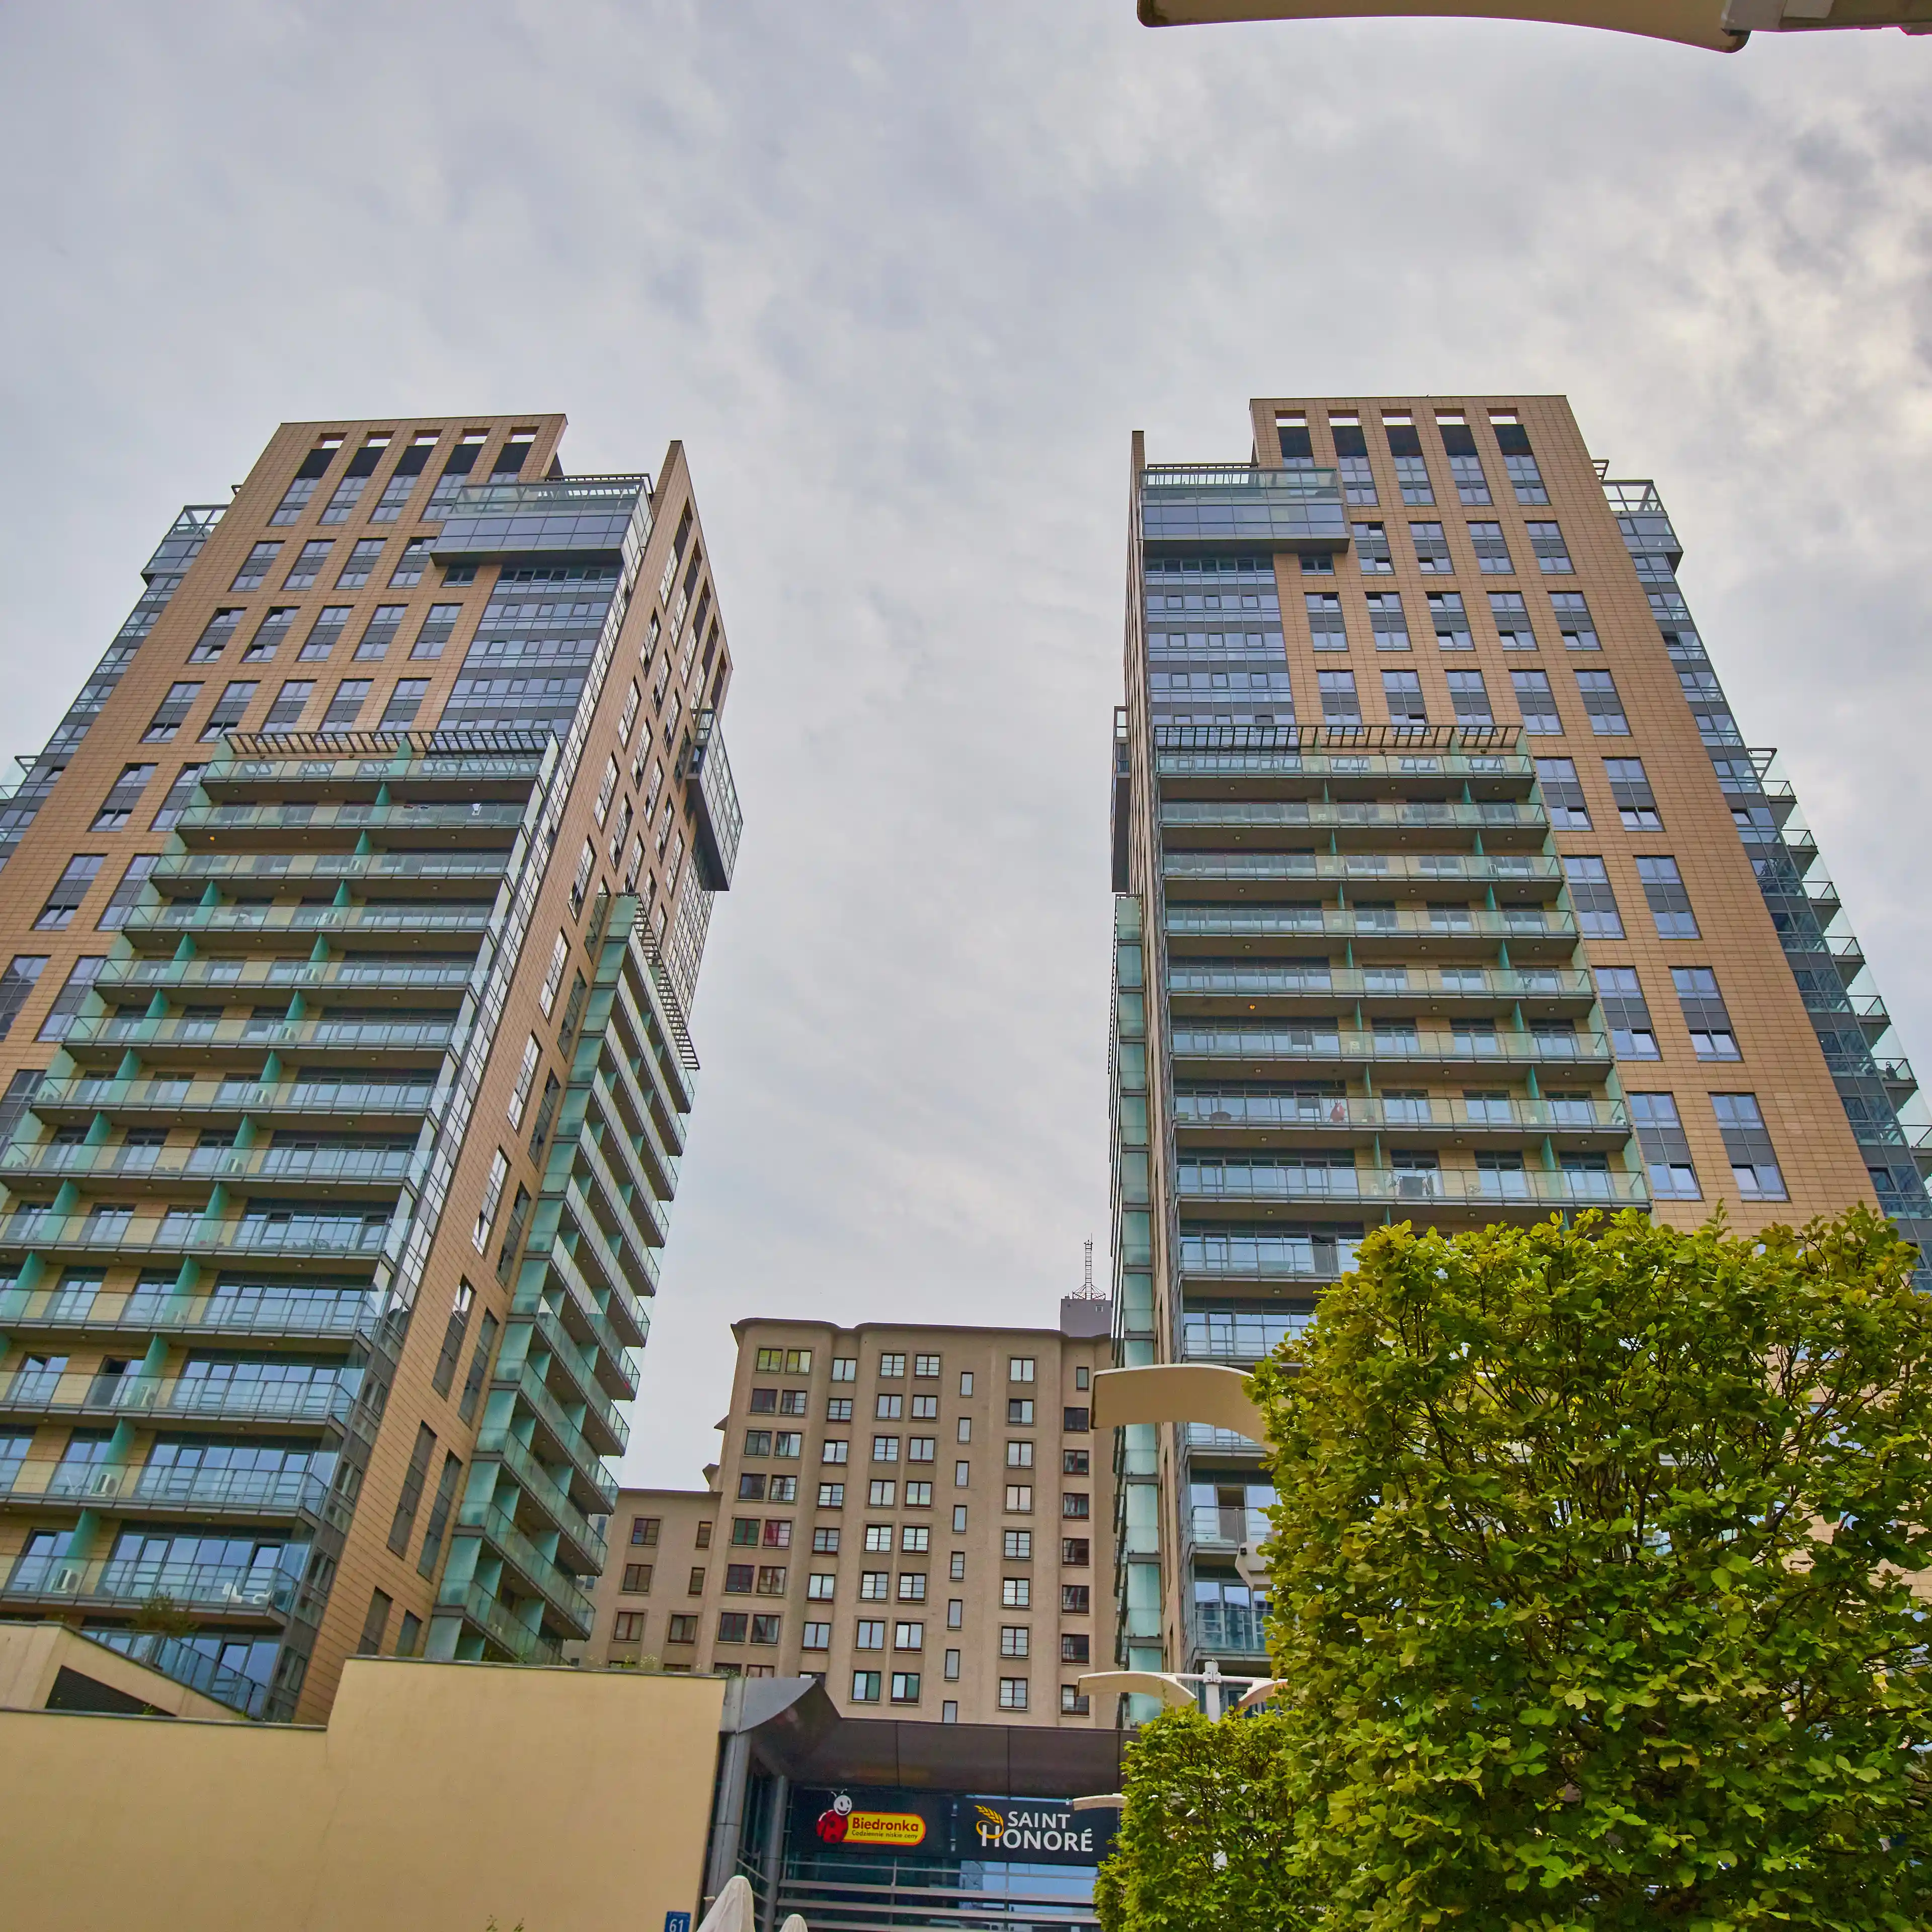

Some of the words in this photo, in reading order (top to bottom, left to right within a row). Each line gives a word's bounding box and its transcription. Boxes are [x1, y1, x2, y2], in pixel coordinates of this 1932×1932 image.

[852, 1817, 919, 1831] Biedronka
[1007, 1811, 1071, 1829] SAINT
[982, 1824, 1093, 1852] HONORÉ
[669, 1919, 684, 1932] 61
